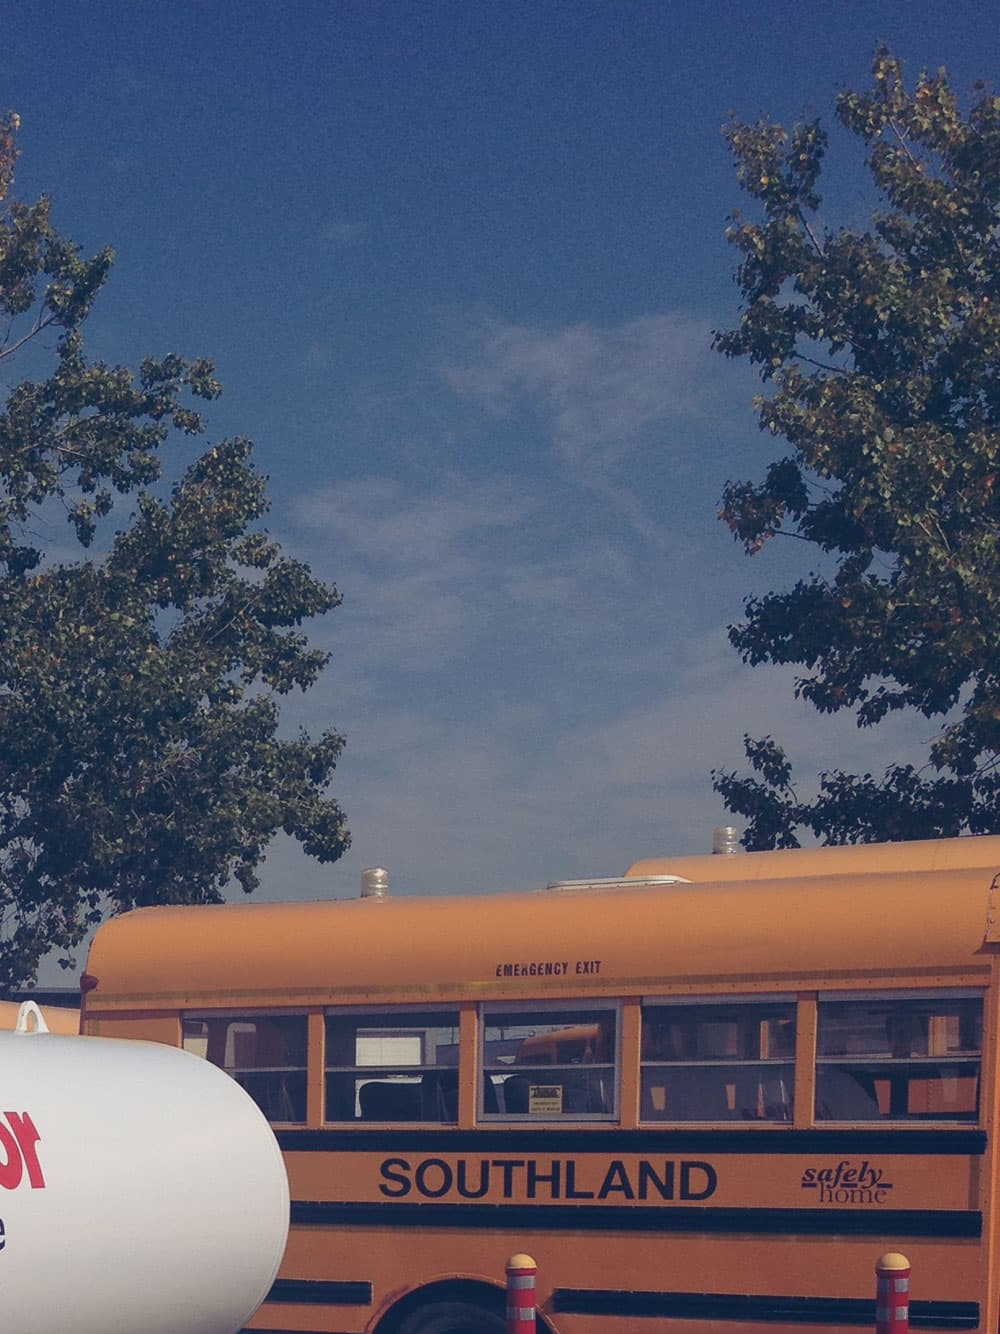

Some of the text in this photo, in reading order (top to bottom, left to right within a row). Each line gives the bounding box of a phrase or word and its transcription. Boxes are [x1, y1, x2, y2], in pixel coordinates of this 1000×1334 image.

[496, 961, 601, 977] EMERGENCY EXIT
[379, 1158, 717, 1200] SOUTHLAND
[801, 1160, 883, 1189] safely
[819, 1182, 887, 1203] home
